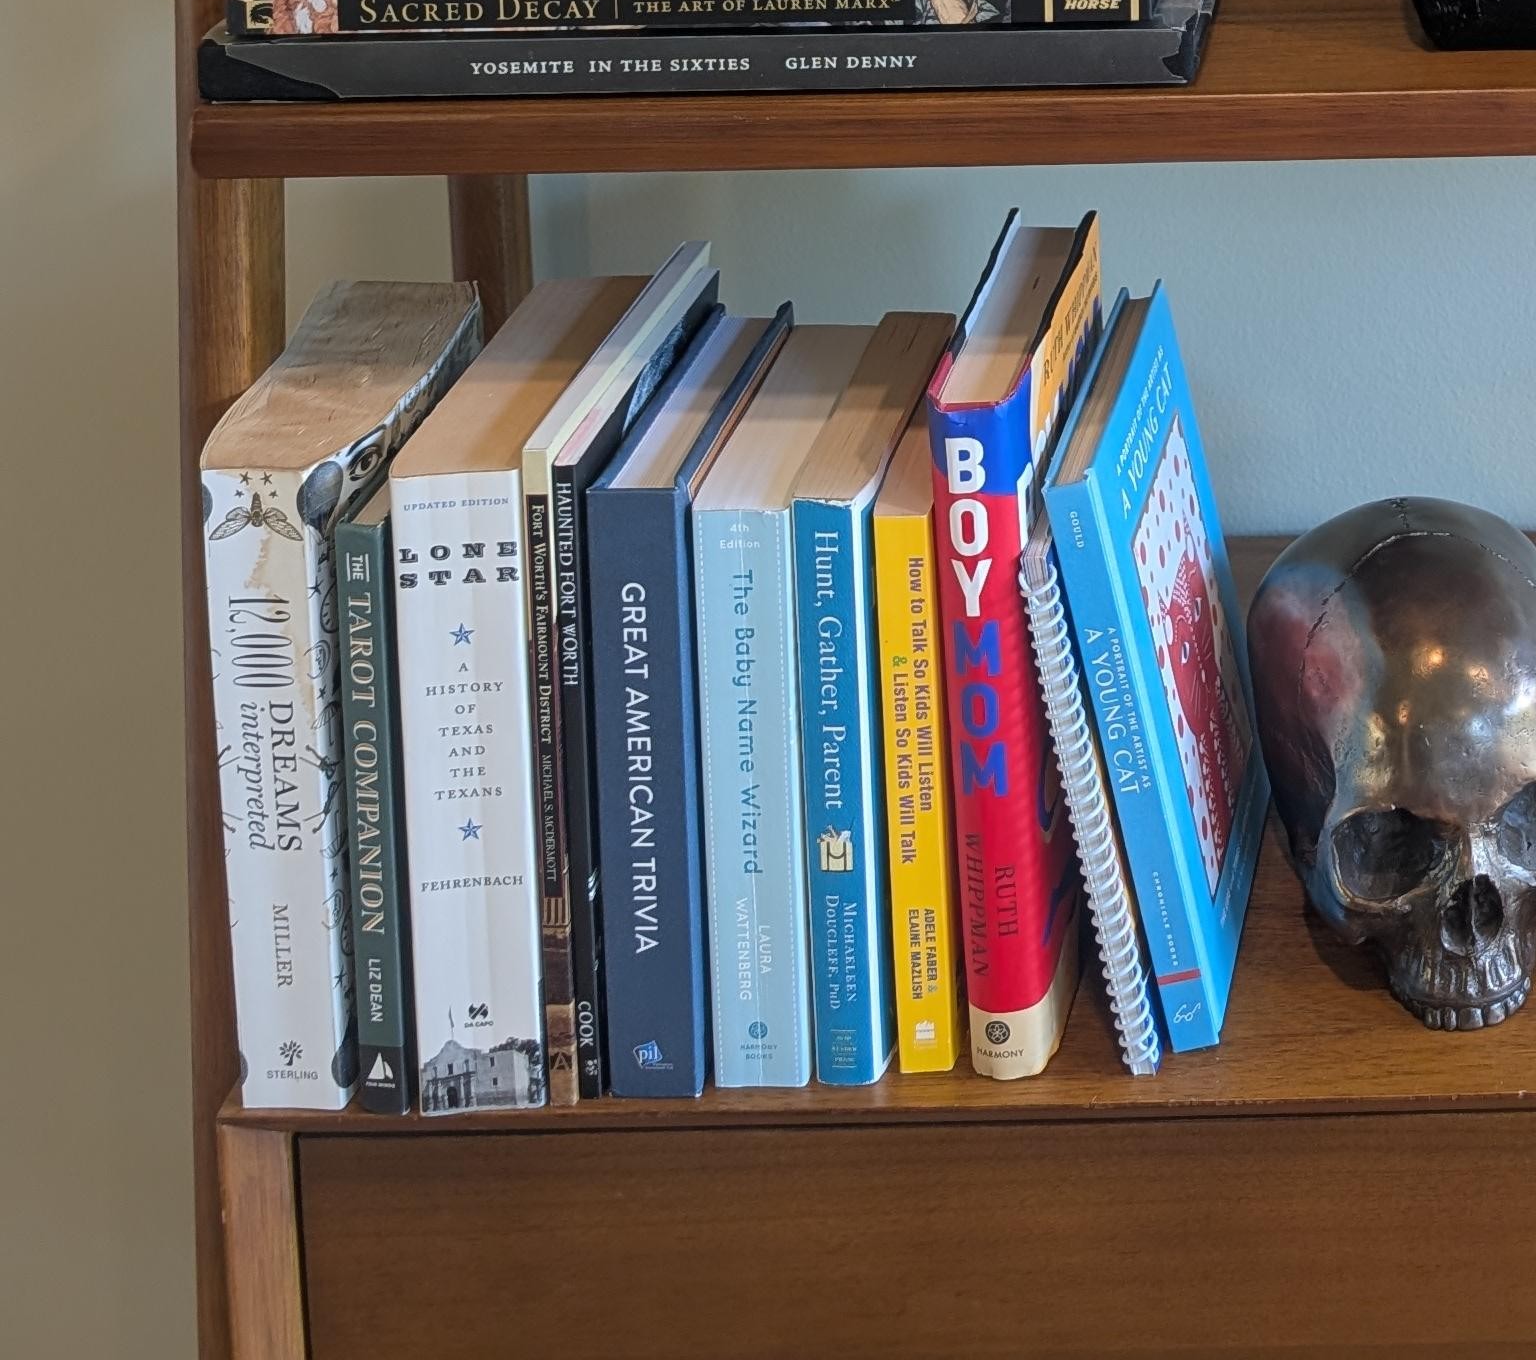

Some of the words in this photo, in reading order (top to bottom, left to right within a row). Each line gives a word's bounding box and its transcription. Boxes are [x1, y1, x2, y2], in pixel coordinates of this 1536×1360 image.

[471, 60, 574, 75] YOSEMITE
[589, 60, 613, 73] IN
[620, 59, 662, 73] THE
[669, 57, 751, 73] SIXTIES
[785, 56, 837, 70] GLEN
[846, 55, 917, 69] DENNY
[404, 500, 457, 511] UPDATED
[461, 497, 510, 508] EDITION
[555, 482, 574, 566] HAUNTED
[399, 541, 518, 563] LONE
[399, 566, 520, 588] STAR
[558, 571, 576, 617] FORT
[228, 594, 295, 688] 12,000
[348, 592, 376, 708] TAROT
[561, 625, 578, 686] WORTH
[622, 582, 648, 679] GREAT
[625, 687, 655, 847] AMERICAN
[1091, 653, 1128, 741] YOUNG
[1113, 753, 1140, 794] CAT
[236, 701, 276, 851] interpreted
[268, 699, 303, 852] DREAMS
[352, 719, 385, 935] COMPANION
[421, 875, 523, 892] FEHRENBACH
[632, 858, 659, 954] TRIVIA
